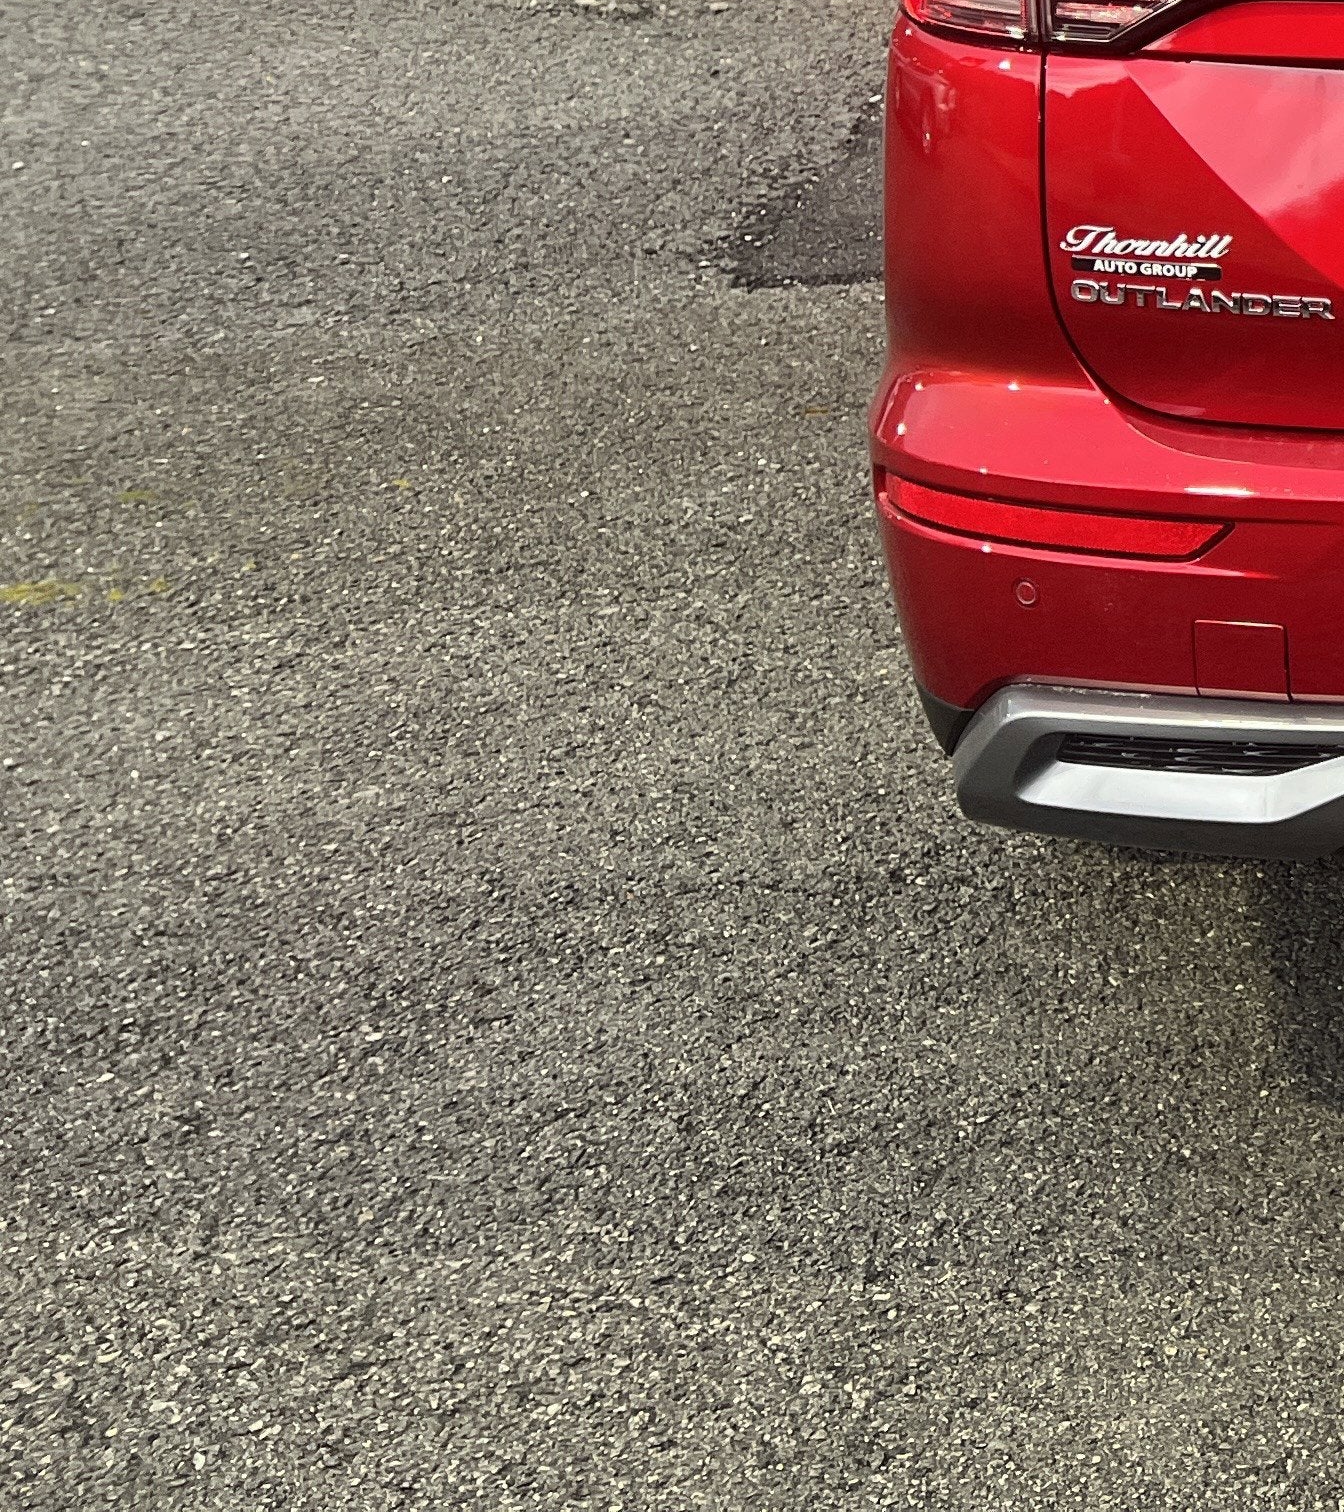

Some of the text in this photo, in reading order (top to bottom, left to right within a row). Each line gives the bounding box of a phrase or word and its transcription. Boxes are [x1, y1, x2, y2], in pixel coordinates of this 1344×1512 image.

[1060, 223, 1233, 259] Thornhill
[1093, 258, 1199, 279] AUTO GROUP
[1070, 279, 1336, 321] OUTLANDER
